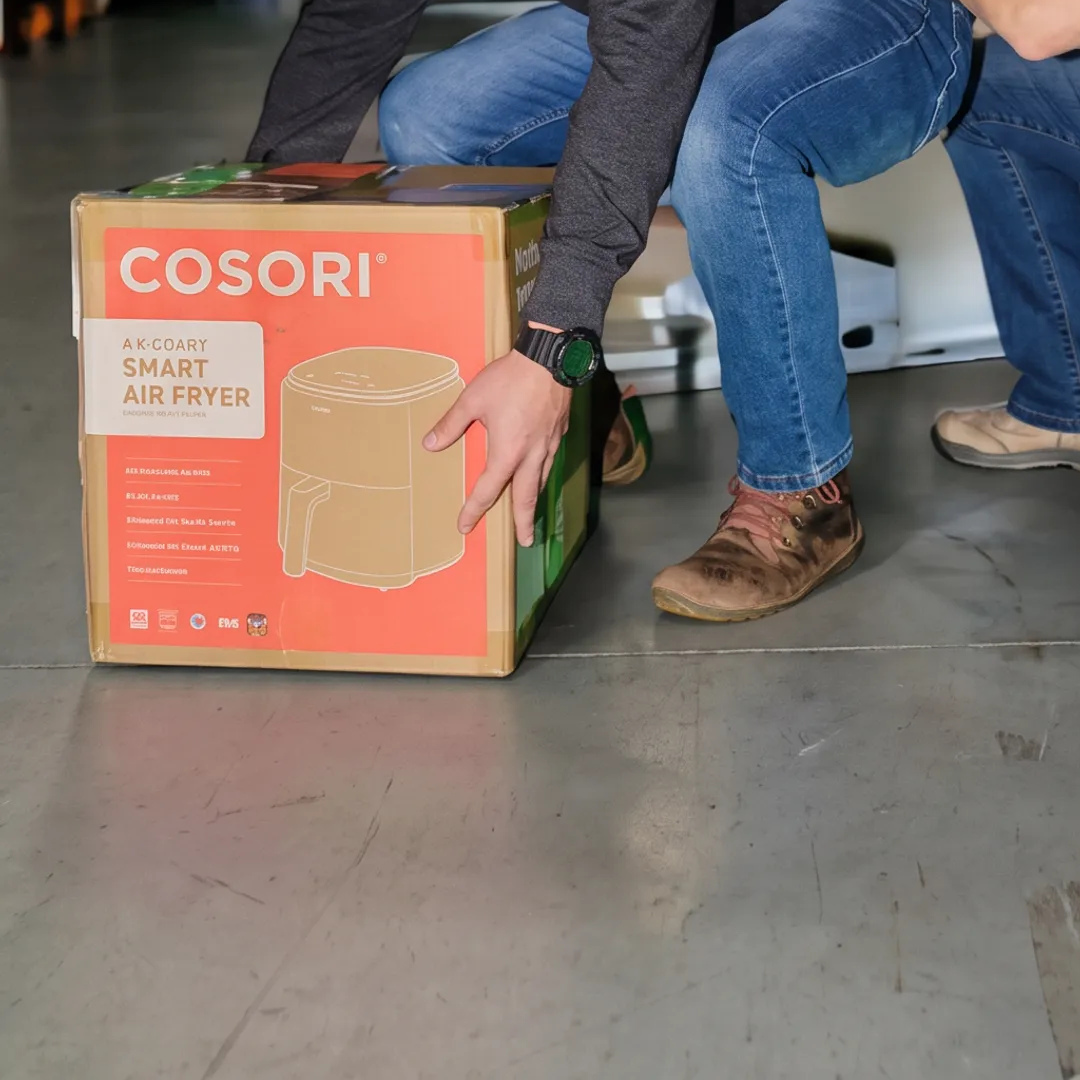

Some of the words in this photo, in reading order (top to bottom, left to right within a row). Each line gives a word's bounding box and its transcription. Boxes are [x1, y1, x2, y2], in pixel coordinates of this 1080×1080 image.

[119, 246, 370, 298] COSORI
[122, 357, 209, 379] SMART
[122, 384, 165, 405] AIR
[172, 385, 250, 408] FRYER
